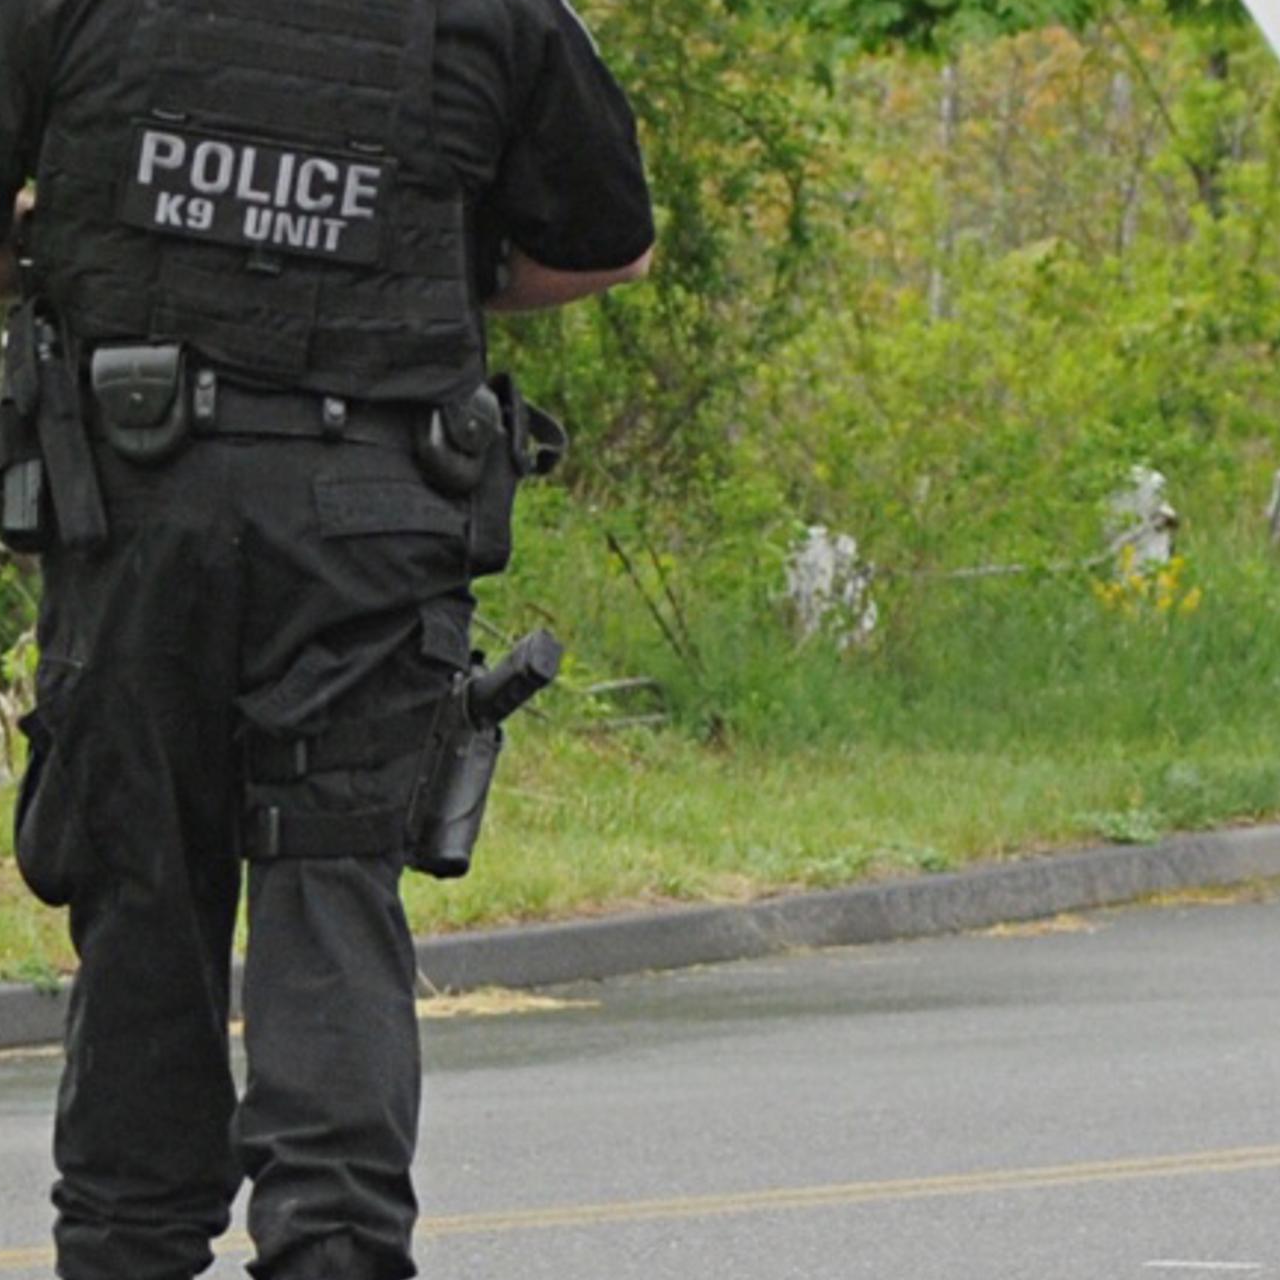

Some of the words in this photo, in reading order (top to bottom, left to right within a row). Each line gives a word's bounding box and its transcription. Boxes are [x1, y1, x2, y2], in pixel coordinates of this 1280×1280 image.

[137, 130, 382, 218] POLICE
[154, 191, 215, 231] K9
[243, 206, 348, 252] UNIT
